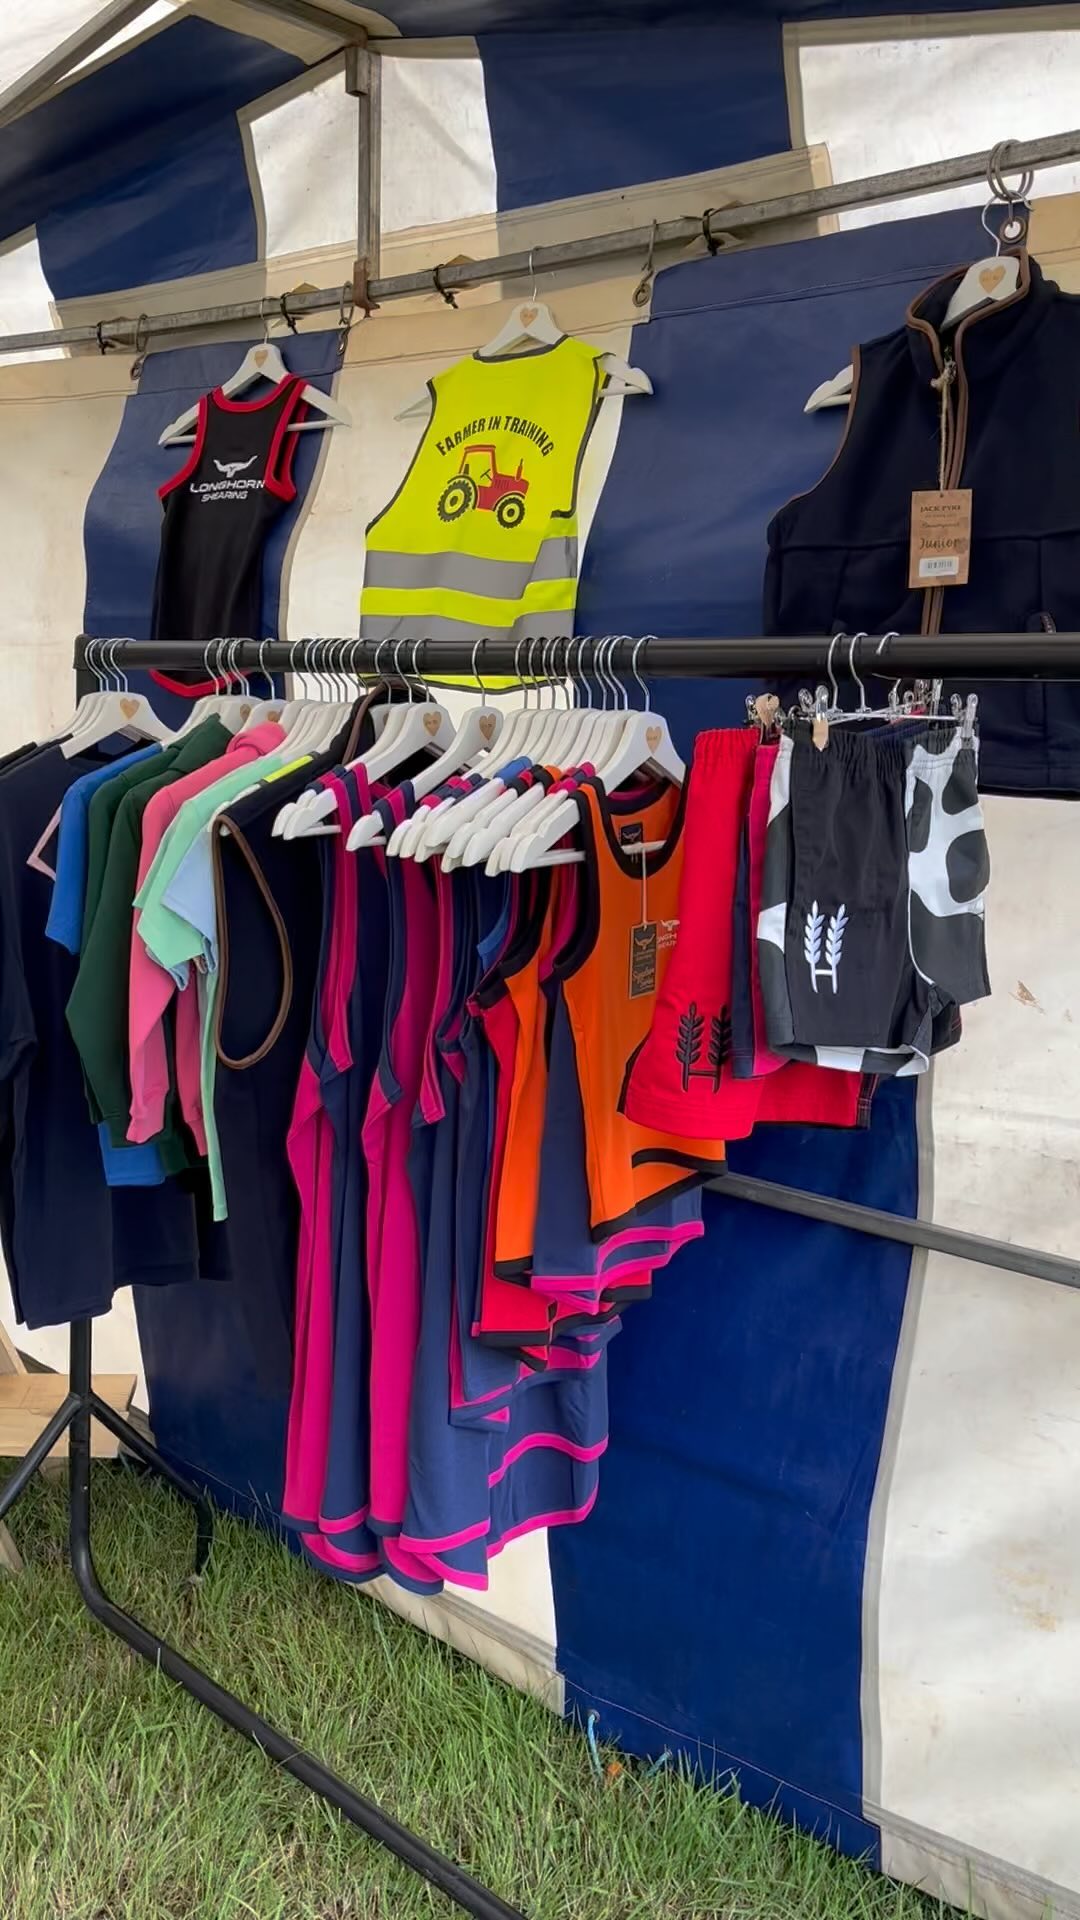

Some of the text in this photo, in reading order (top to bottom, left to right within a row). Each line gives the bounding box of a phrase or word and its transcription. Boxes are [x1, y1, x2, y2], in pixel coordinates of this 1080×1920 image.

[435, 415, 555, 457] FARMER IN TRAINING
[190, 479, 265, 493] LONGHORN
[200, 490, 248, 503] SHEARING
[920, 505, 940, 513] JACK
[919, 537, 961, 551] Junior
